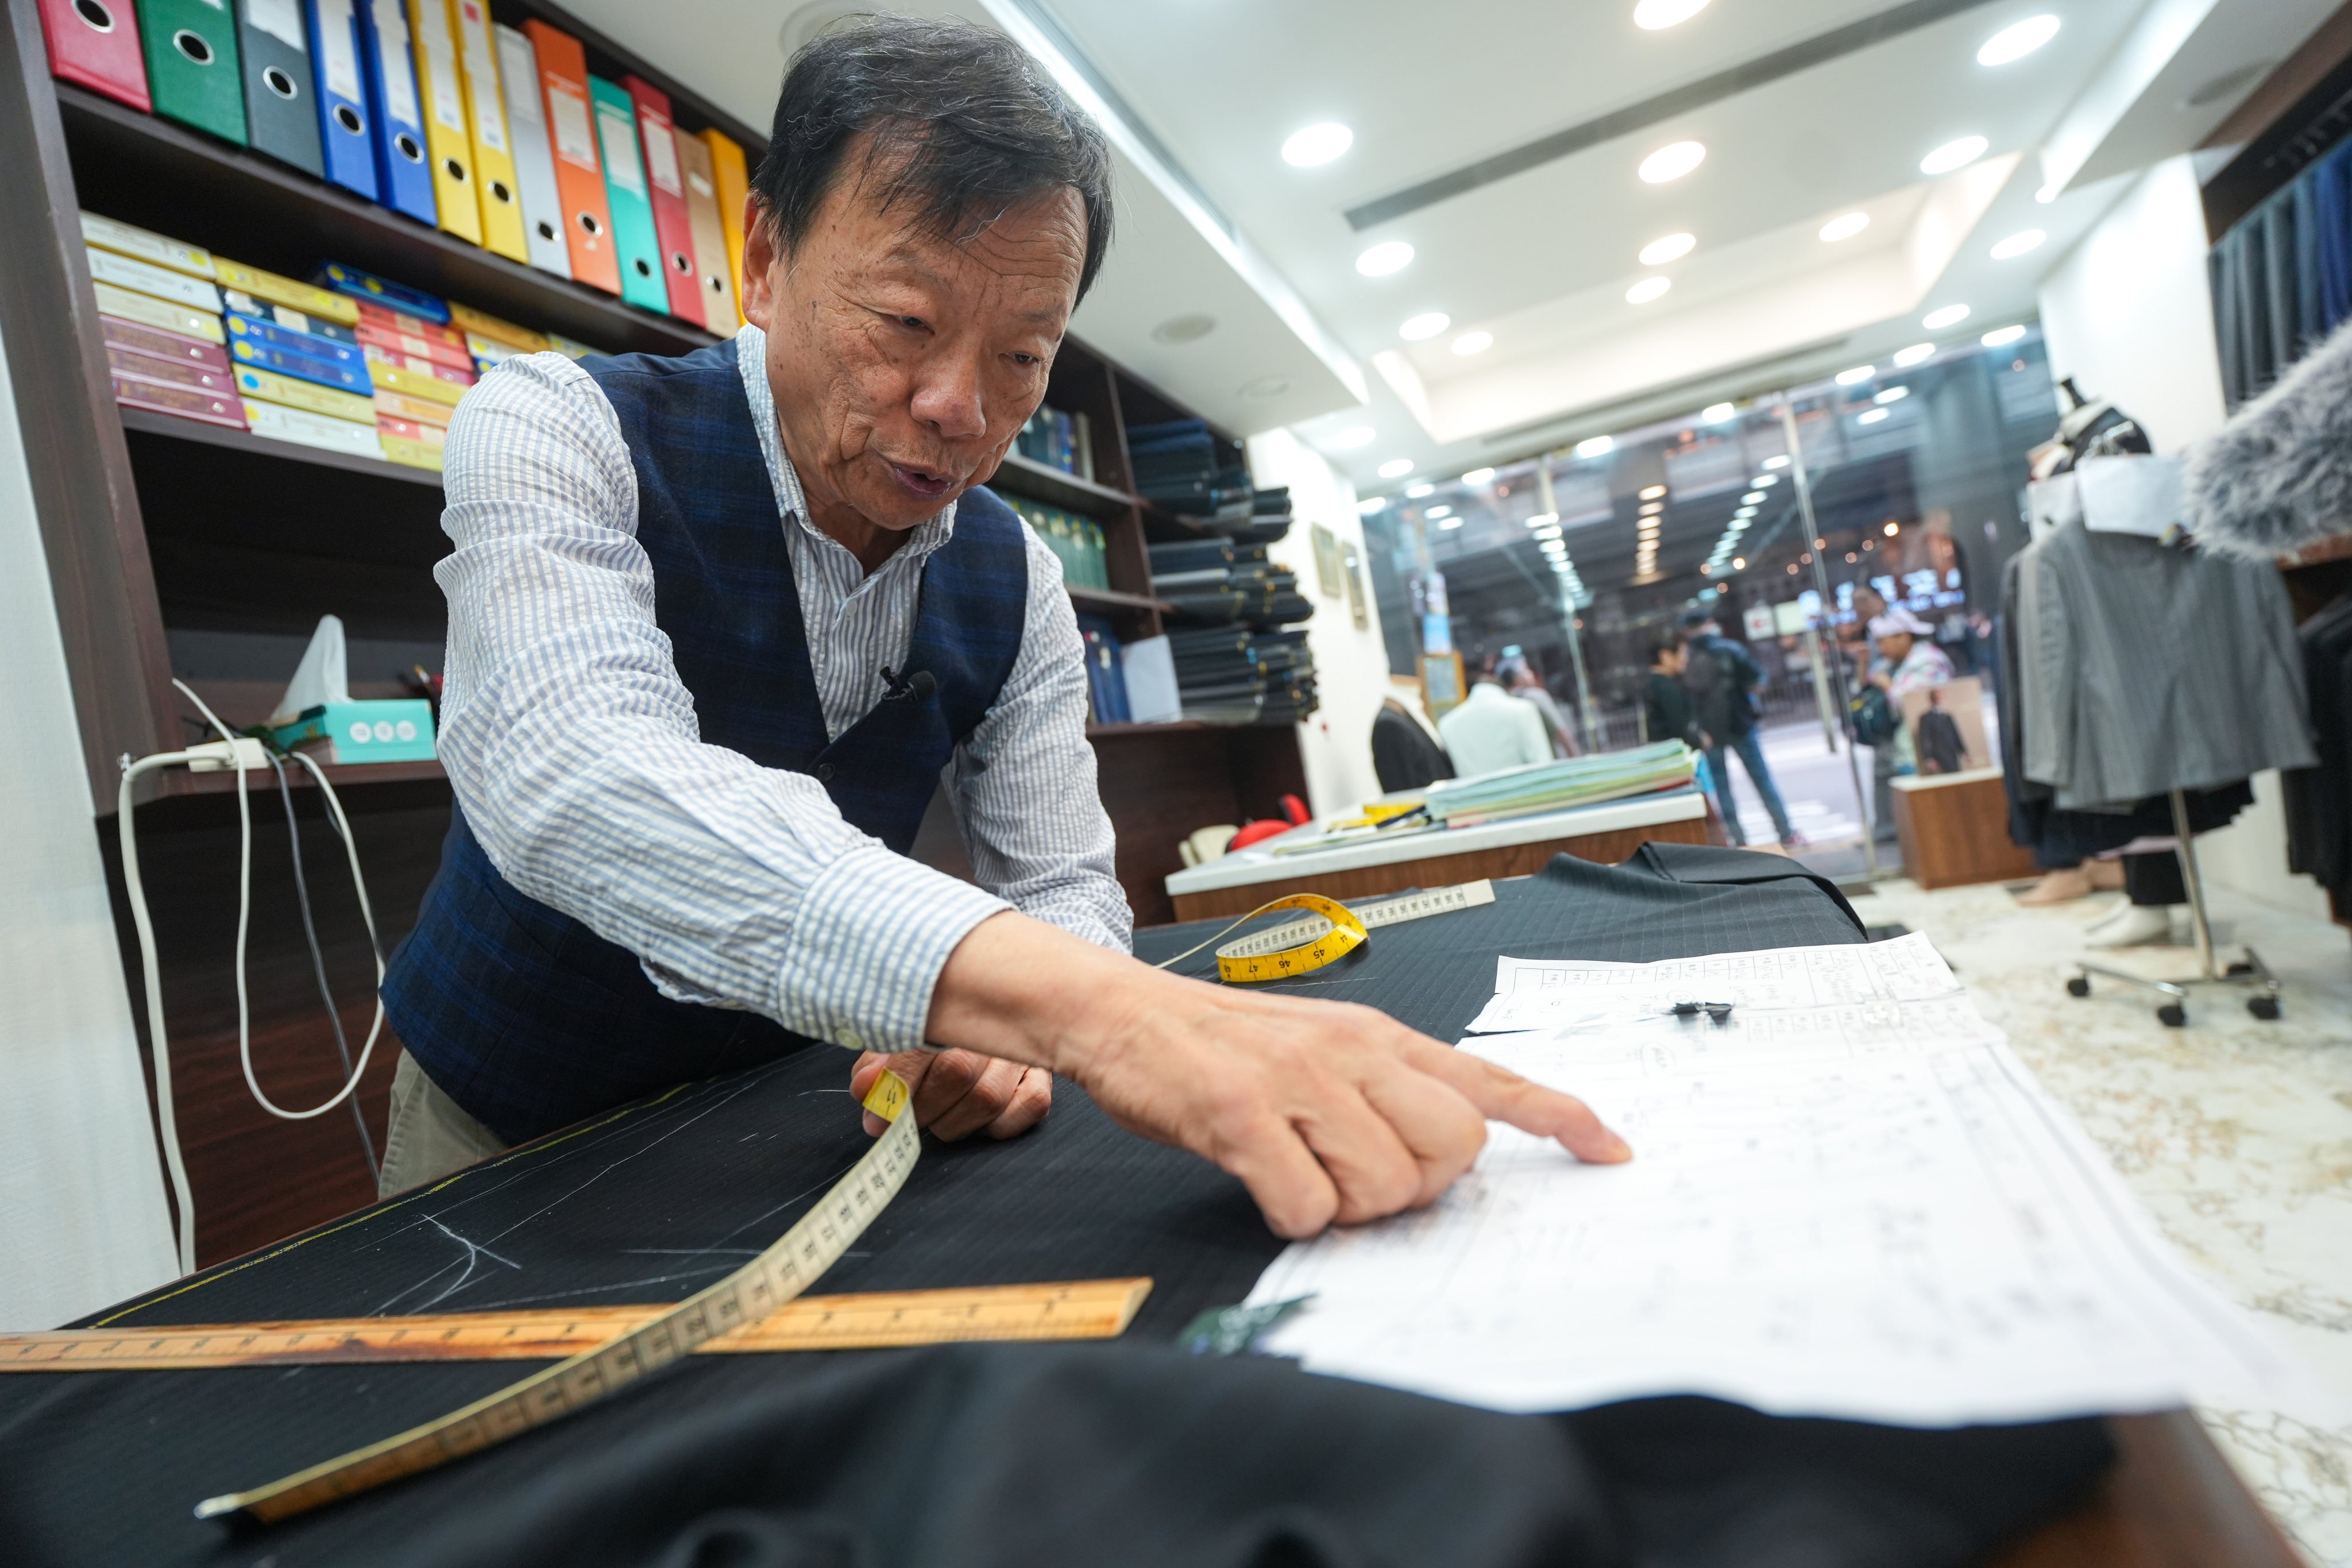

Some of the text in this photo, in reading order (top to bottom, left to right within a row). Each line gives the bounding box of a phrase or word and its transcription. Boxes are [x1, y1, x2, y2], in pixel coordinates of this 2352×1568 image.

[1314, 948, 1325, 959] 45
[1249, 964, 1258, 972] 47
[1279, 960, 1291, 968] 46
[886, 1089, 897, 1104] 11
